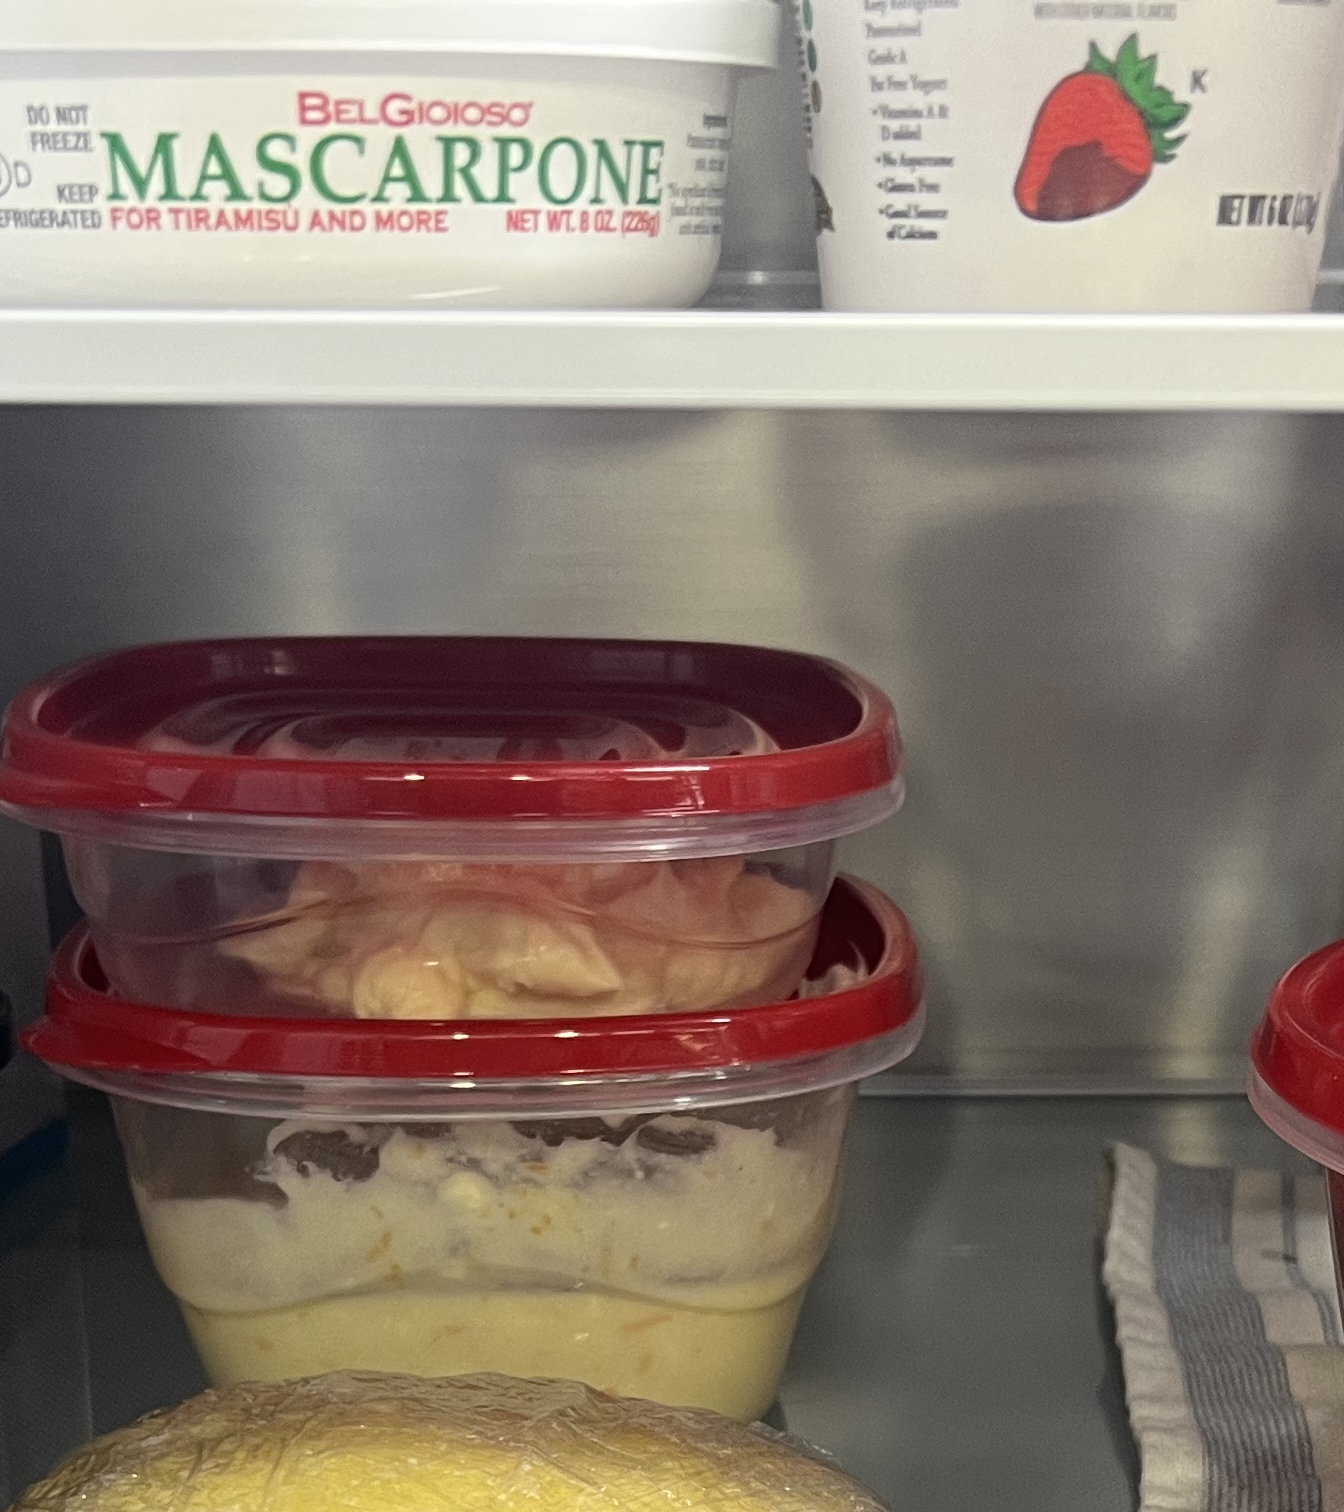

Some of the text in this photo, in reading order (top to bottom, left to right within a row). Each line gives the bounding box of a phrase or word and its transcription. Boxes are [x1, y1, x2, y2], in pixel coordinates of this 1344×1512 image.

[1190, 69, 1208, 94] K
[26, 105, 89, 126] DO NOT
[30, 131, 93, 152] FREEZE
[100, 131, 665, 205] MASCARPONE
[56, 184, 98, 203] KEEP
[110, 206, 161, 231] FOR
[308, 208, 366, 232] AND
[374, 209, 449, 233] MORE
[506, 208, 541, 233] NET
[546, 209, 575, 233] WT.
[579, 209, 589, 233] 8
